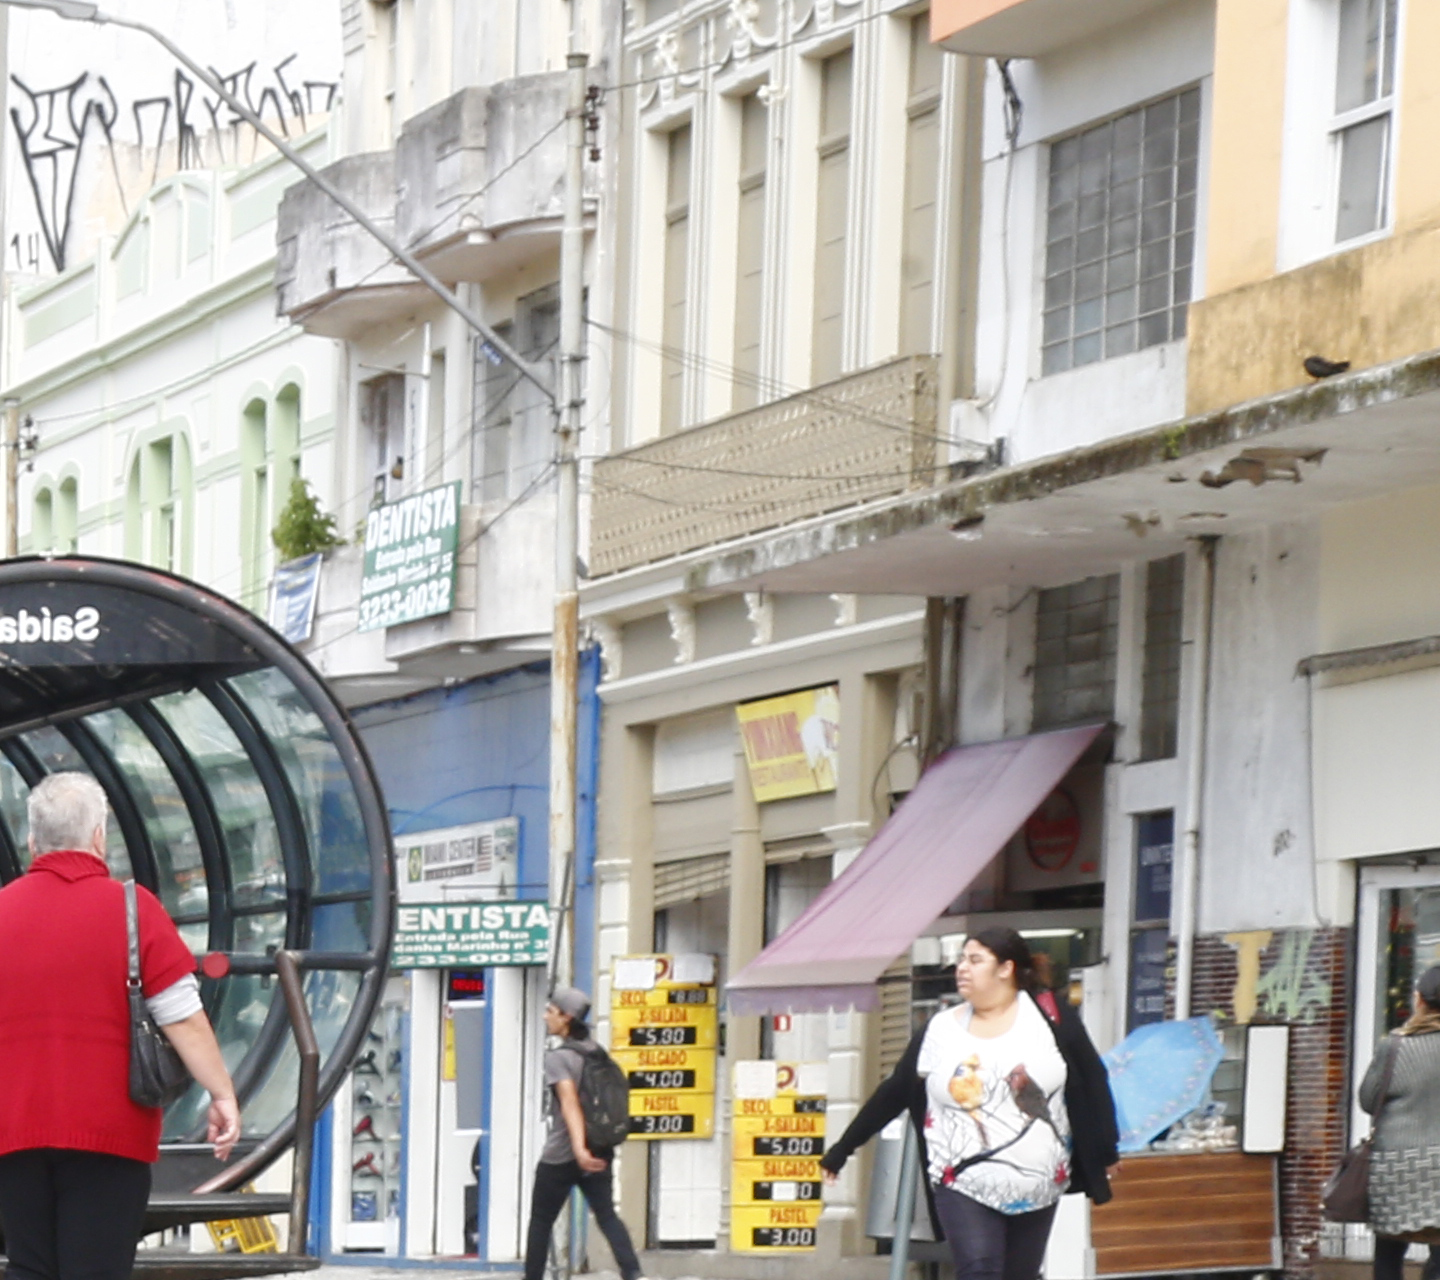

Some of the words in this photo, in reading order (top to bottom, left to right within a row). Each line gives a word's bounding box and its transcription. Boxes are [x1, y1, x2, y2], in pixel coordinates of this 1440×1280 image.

[366, 485, 456, 551] DENTISTA
[360, 577, 451, 632] 3233-0032
[398, 904, 549, 931] ENTISTA
[395, 931, 456, 943] Entrada
[461, 931, 494, 943] pela
[499, 930, 529, 940] Rua
[394, 942, 442, 953] danha
[391, 952, 548, 966] 233-0032
[639, 1008, 688, 1024] X-SALADA
[638, 1050, 687, 1066] SALGADO
[643, 1096, 679, 1112] PASTEL
[743, 1099, 773, 1114] SKOL
[764, 1117, 816, 1133] X-SALADA
[764, 1160, 817, 1177] SALGADO
[770, 1208, 808, 1223] PASTEL
